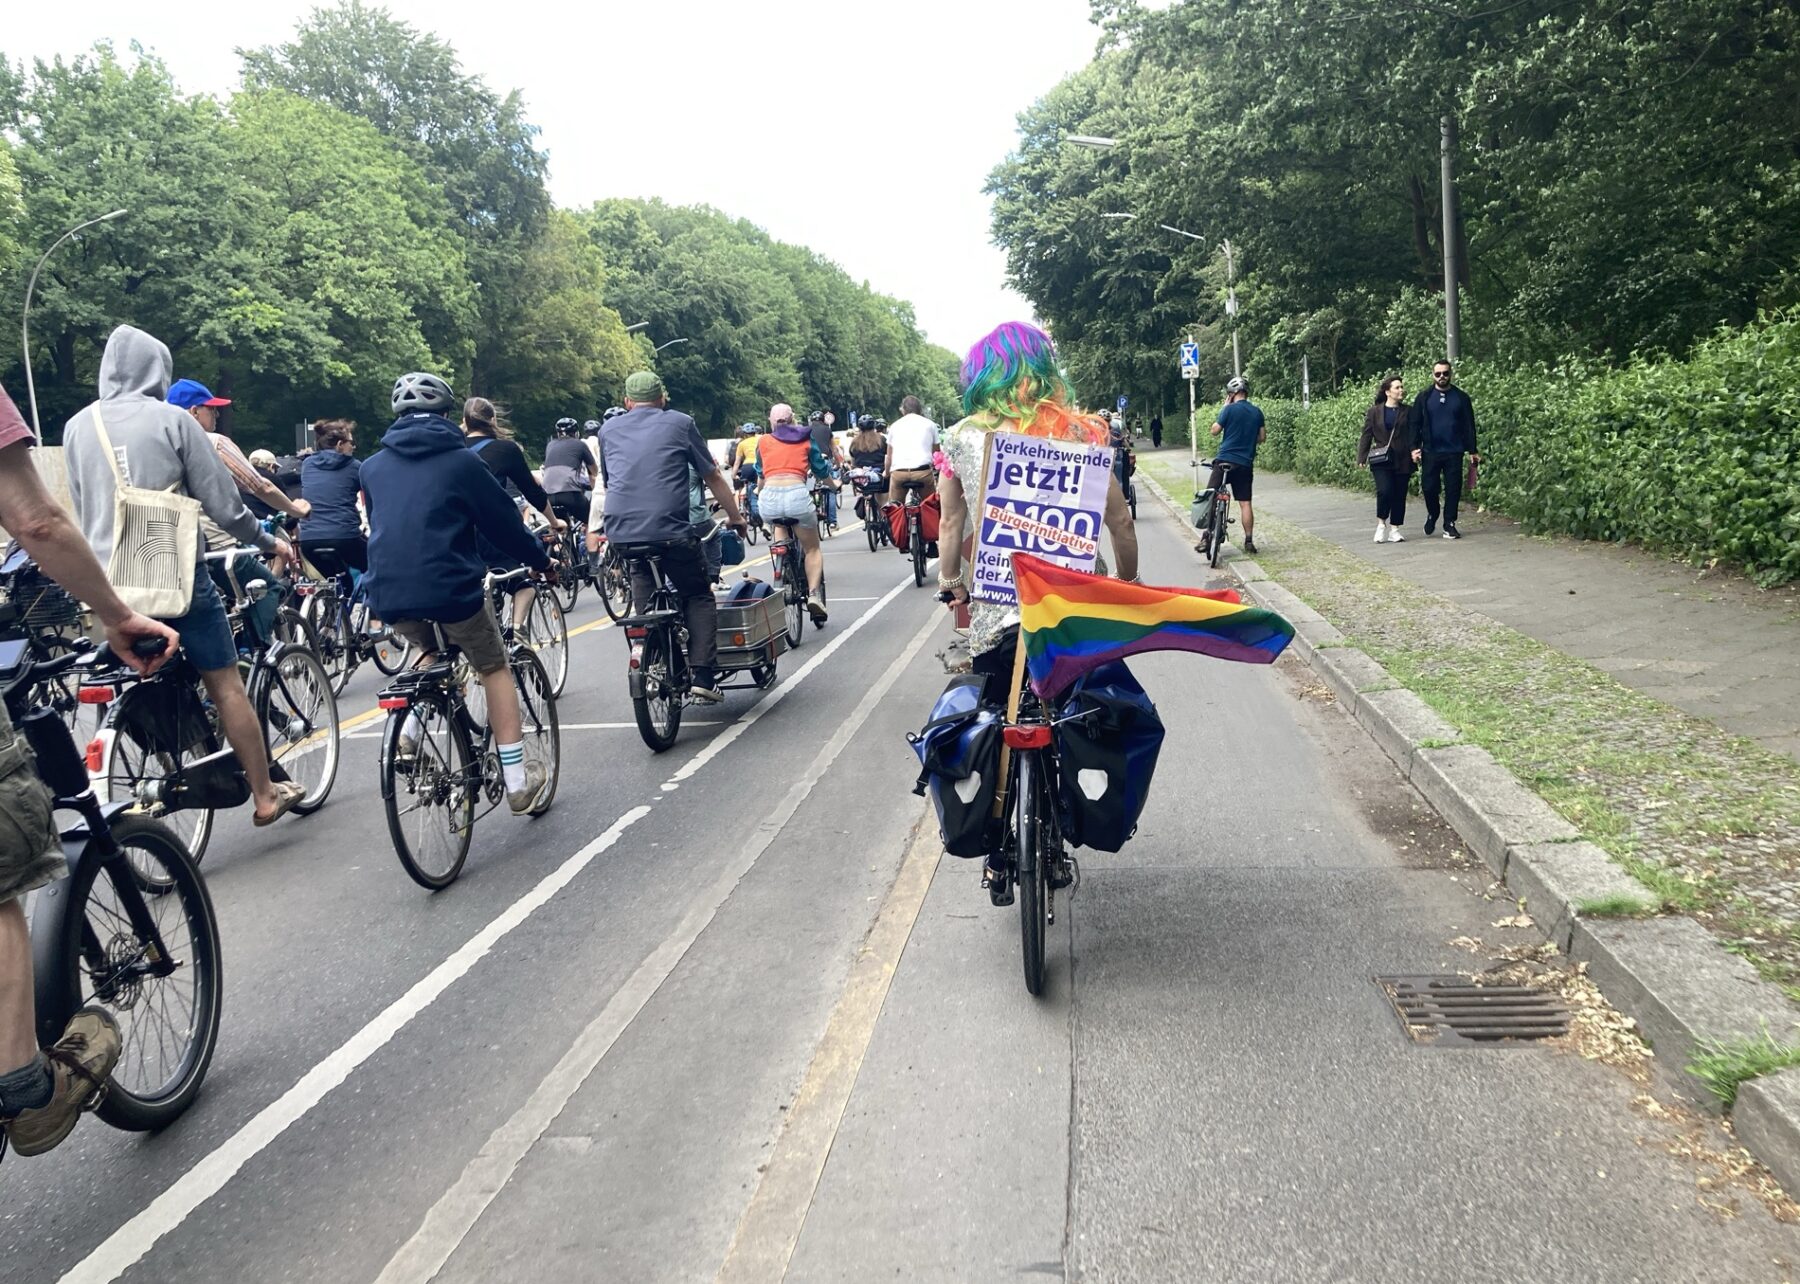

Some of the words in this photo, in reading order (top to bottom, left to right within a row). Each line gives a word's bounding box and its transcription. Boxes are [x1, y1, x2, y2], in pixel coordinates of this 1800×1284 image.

[995, 438, 1111, 468] Verkehrswende
[988, 453, 1082, 494] jetzt!
[986, 501, 1095, 556] A100
[989, 507, 1094, 553] Bürgerinitiative
[975, 566, 1002, 582] der
[977, 550, 1011, 568] Kein
[981, 589, 1018, 604] www.
